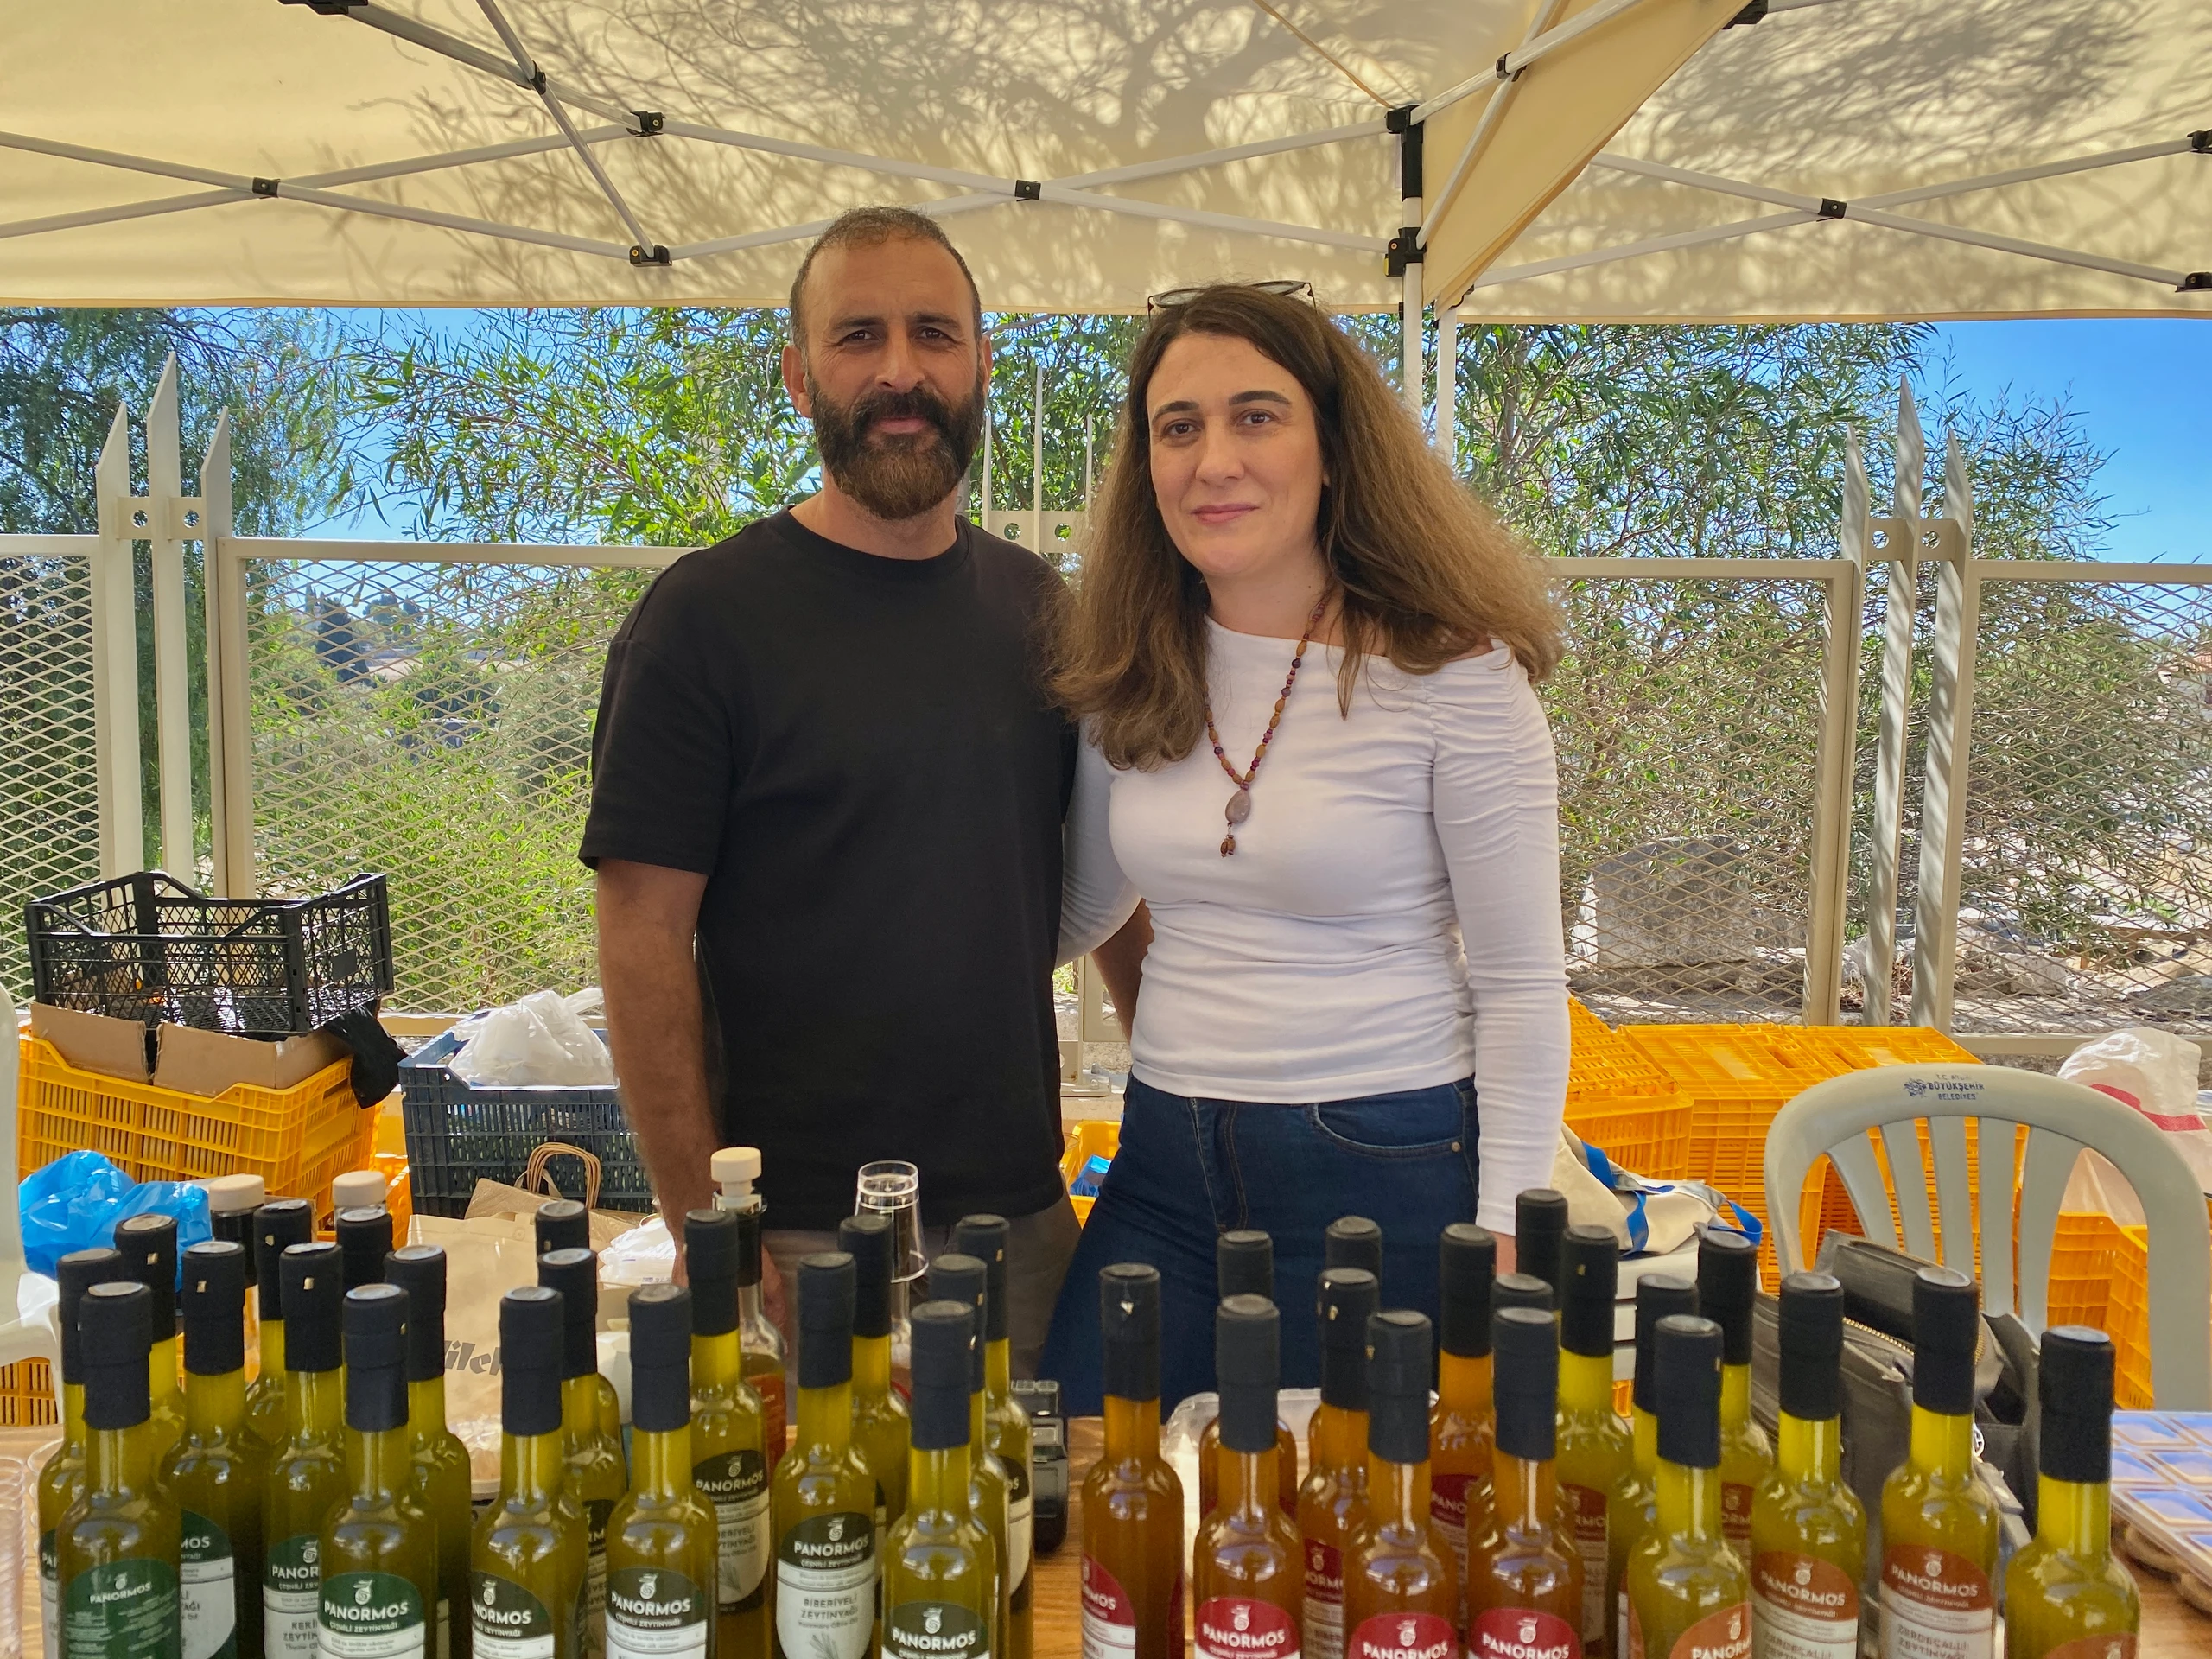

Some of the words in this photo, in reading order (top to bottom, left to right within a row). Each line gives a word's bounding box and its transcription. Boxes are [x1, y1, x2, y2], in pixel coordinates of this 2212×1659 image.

[1928, 1080, 1985, 1091] BÜYÜKŞEHİR
[696, 1470, 764, 1492] PANORMOS
[794, 1533, 869, 1557] PANORMOS
[272, 1565, 319, 1580] PANOR
[1891, 1564, 1978, 1598] PANORMOS
[89, 1580, 153, 1605] PANORMOS
[1761, 1571, 1846, 1606] PANORMOS
[324, 1600, 409, 1621] PANORMOS
[472, 1600, 533, 1625] NORMOS
[611, 1591, 691, 1616] PANORMOS
[891, 1626, 976, 1651] PANORMOS
[1202, 1623, 1286, 1649] PANORMOS
[1481, 1632, 1570, 1659] PANORMOS
[1691, 1637, 1752, 1659] PANORM
[1363, 1641, 1448, 1659] PANORMOS
